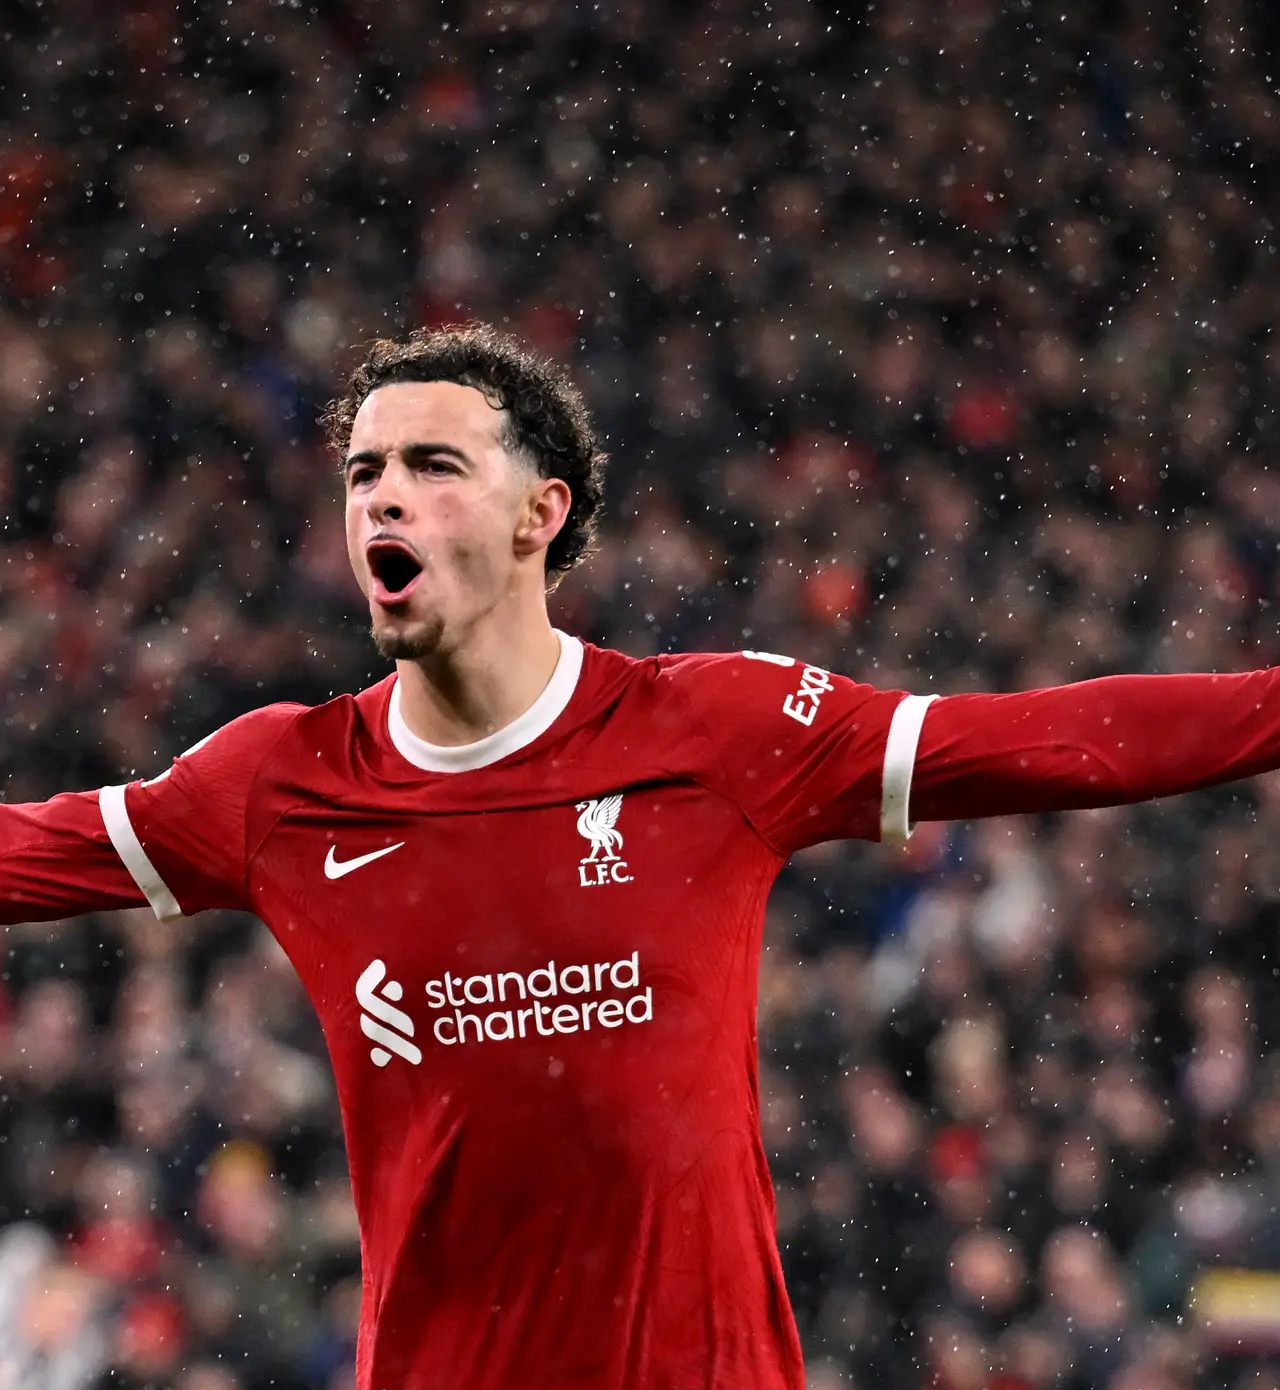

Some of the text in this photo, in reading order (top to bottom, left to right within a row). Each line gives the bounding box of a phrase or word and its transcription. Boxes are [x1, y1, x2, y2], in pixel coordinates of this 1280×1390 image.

[782, 663, 835, 727] Exp
[425, 950, 640, 1009] standard
[433, 986, 653, 1045] chartered
